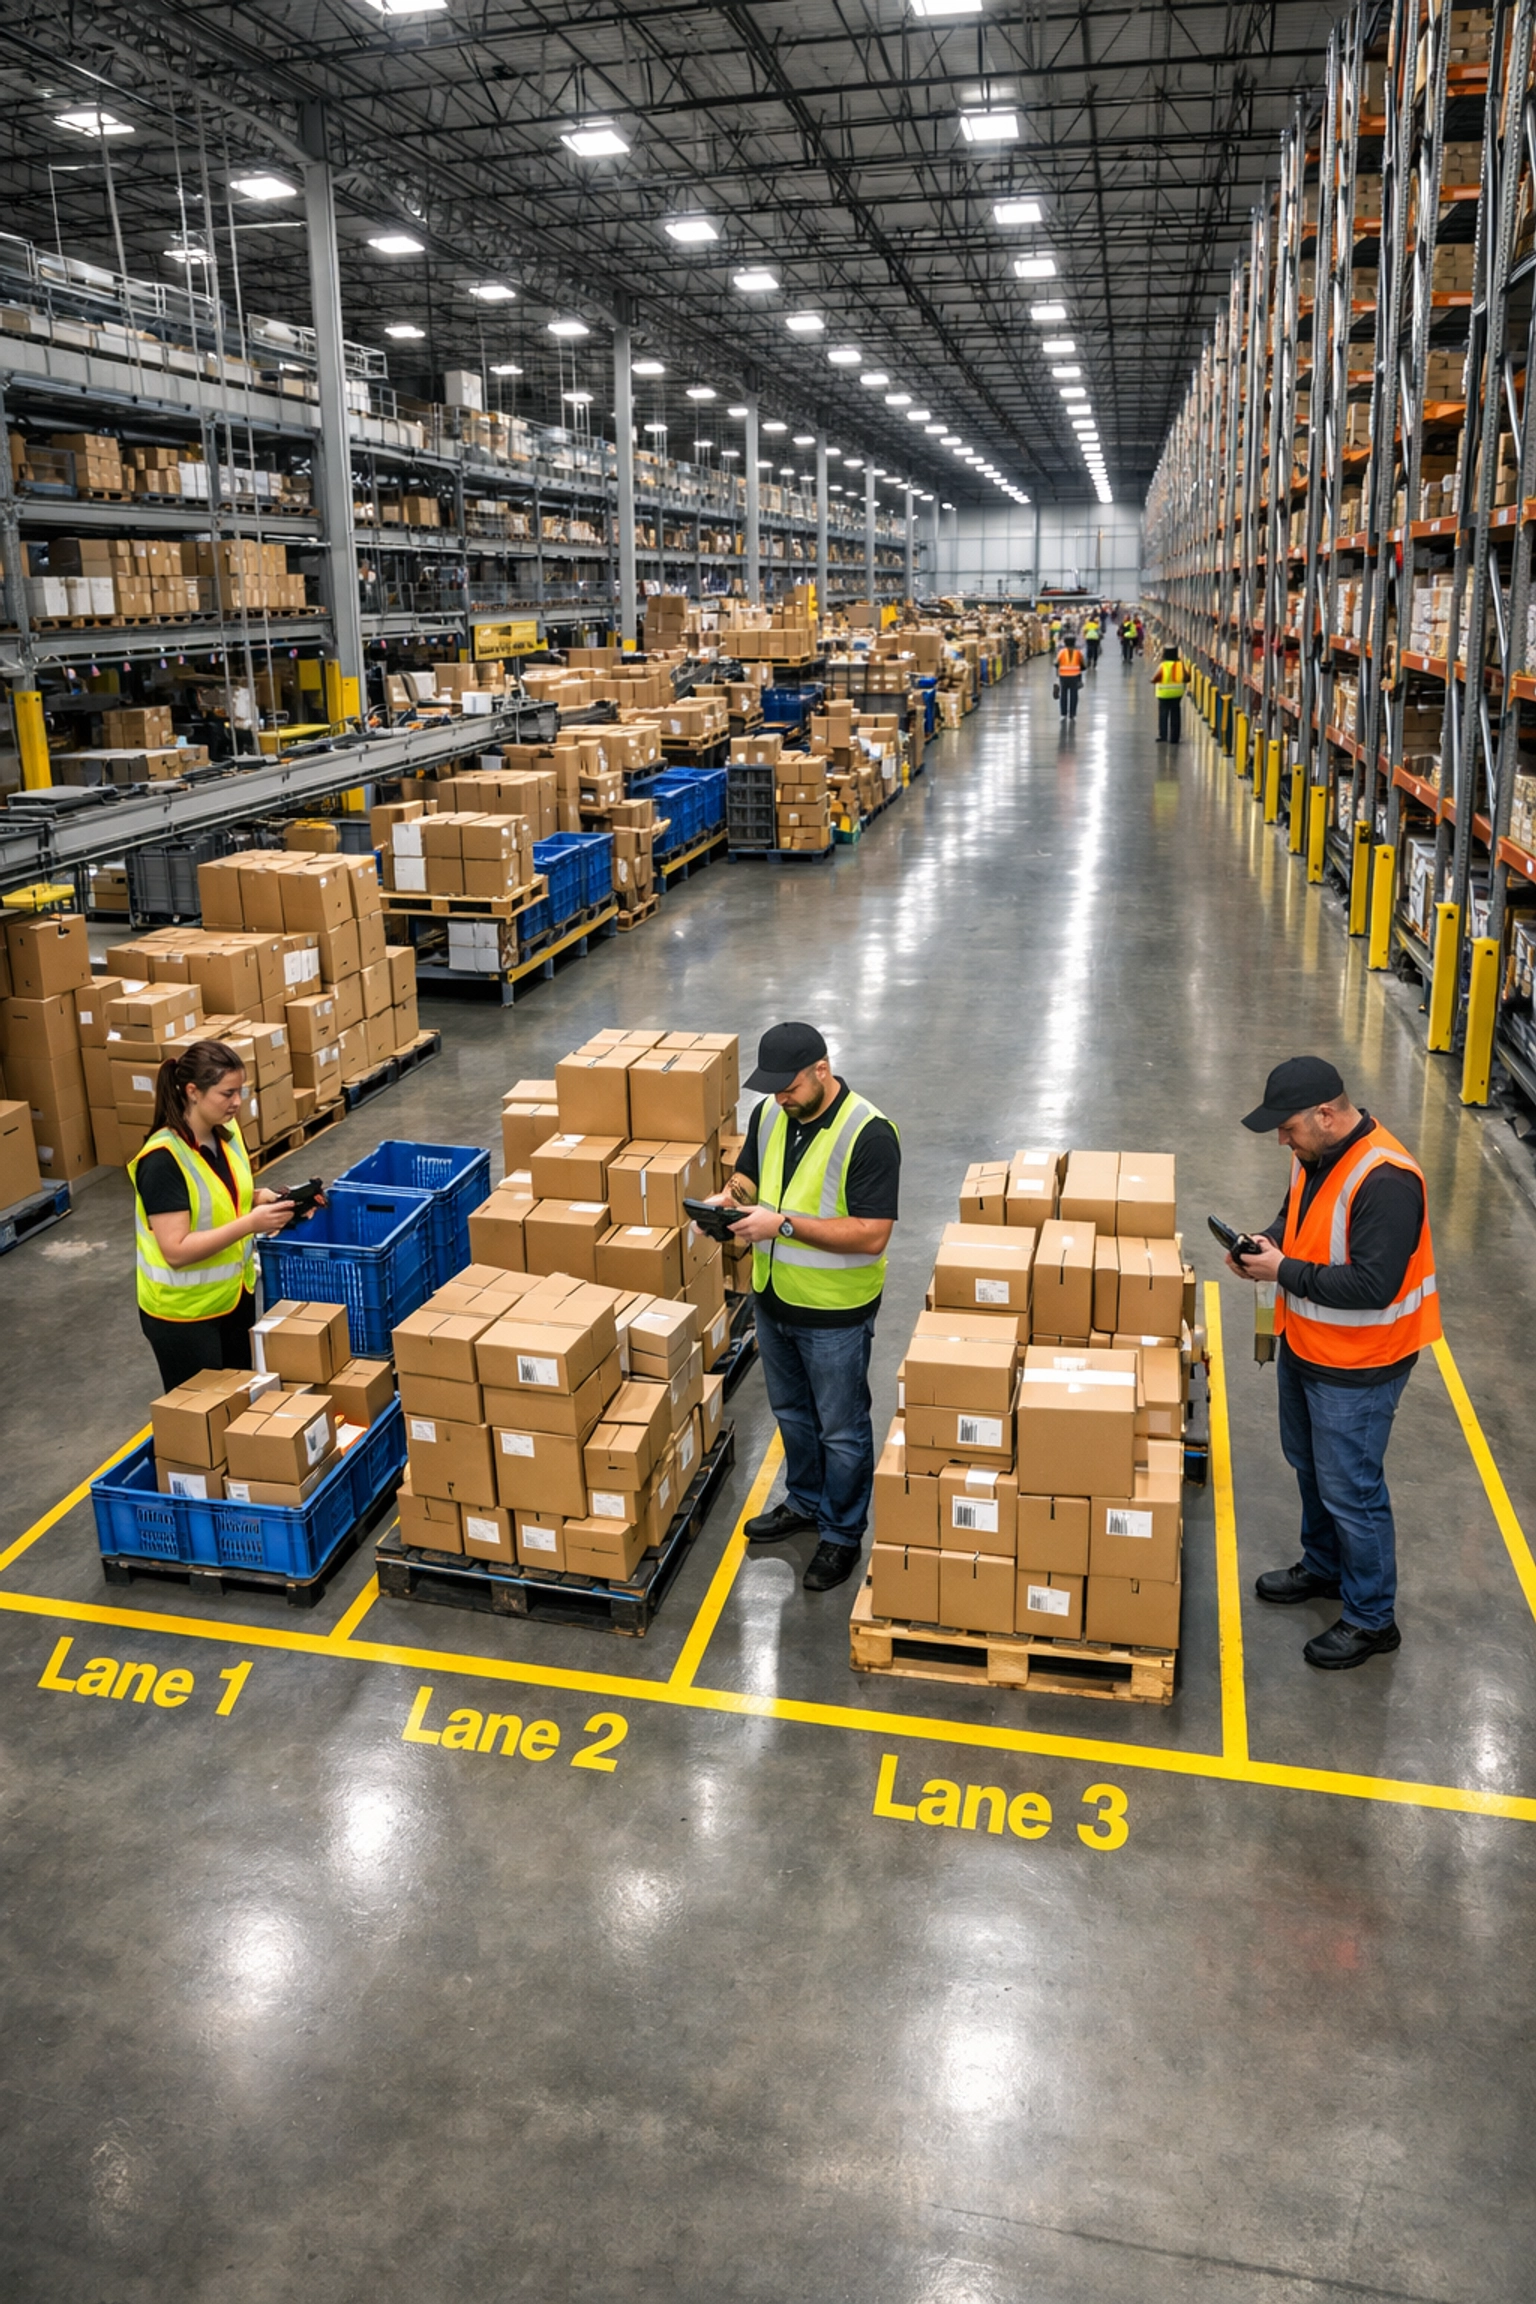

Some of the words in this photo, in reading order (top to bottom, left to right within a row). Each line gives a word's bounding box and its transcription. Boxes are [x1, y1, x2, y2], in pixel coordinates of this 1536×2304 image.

[37, 1635, 195, 1708] Lane
[215, 1660, 253, 1716] 1
[406, 1685, 561, 1762] Lane
[570, 1711, 629, 1773] 2
[872, 1752, 1053, 1840] Lane
[1076, 1782, 1130, 1852] 3
